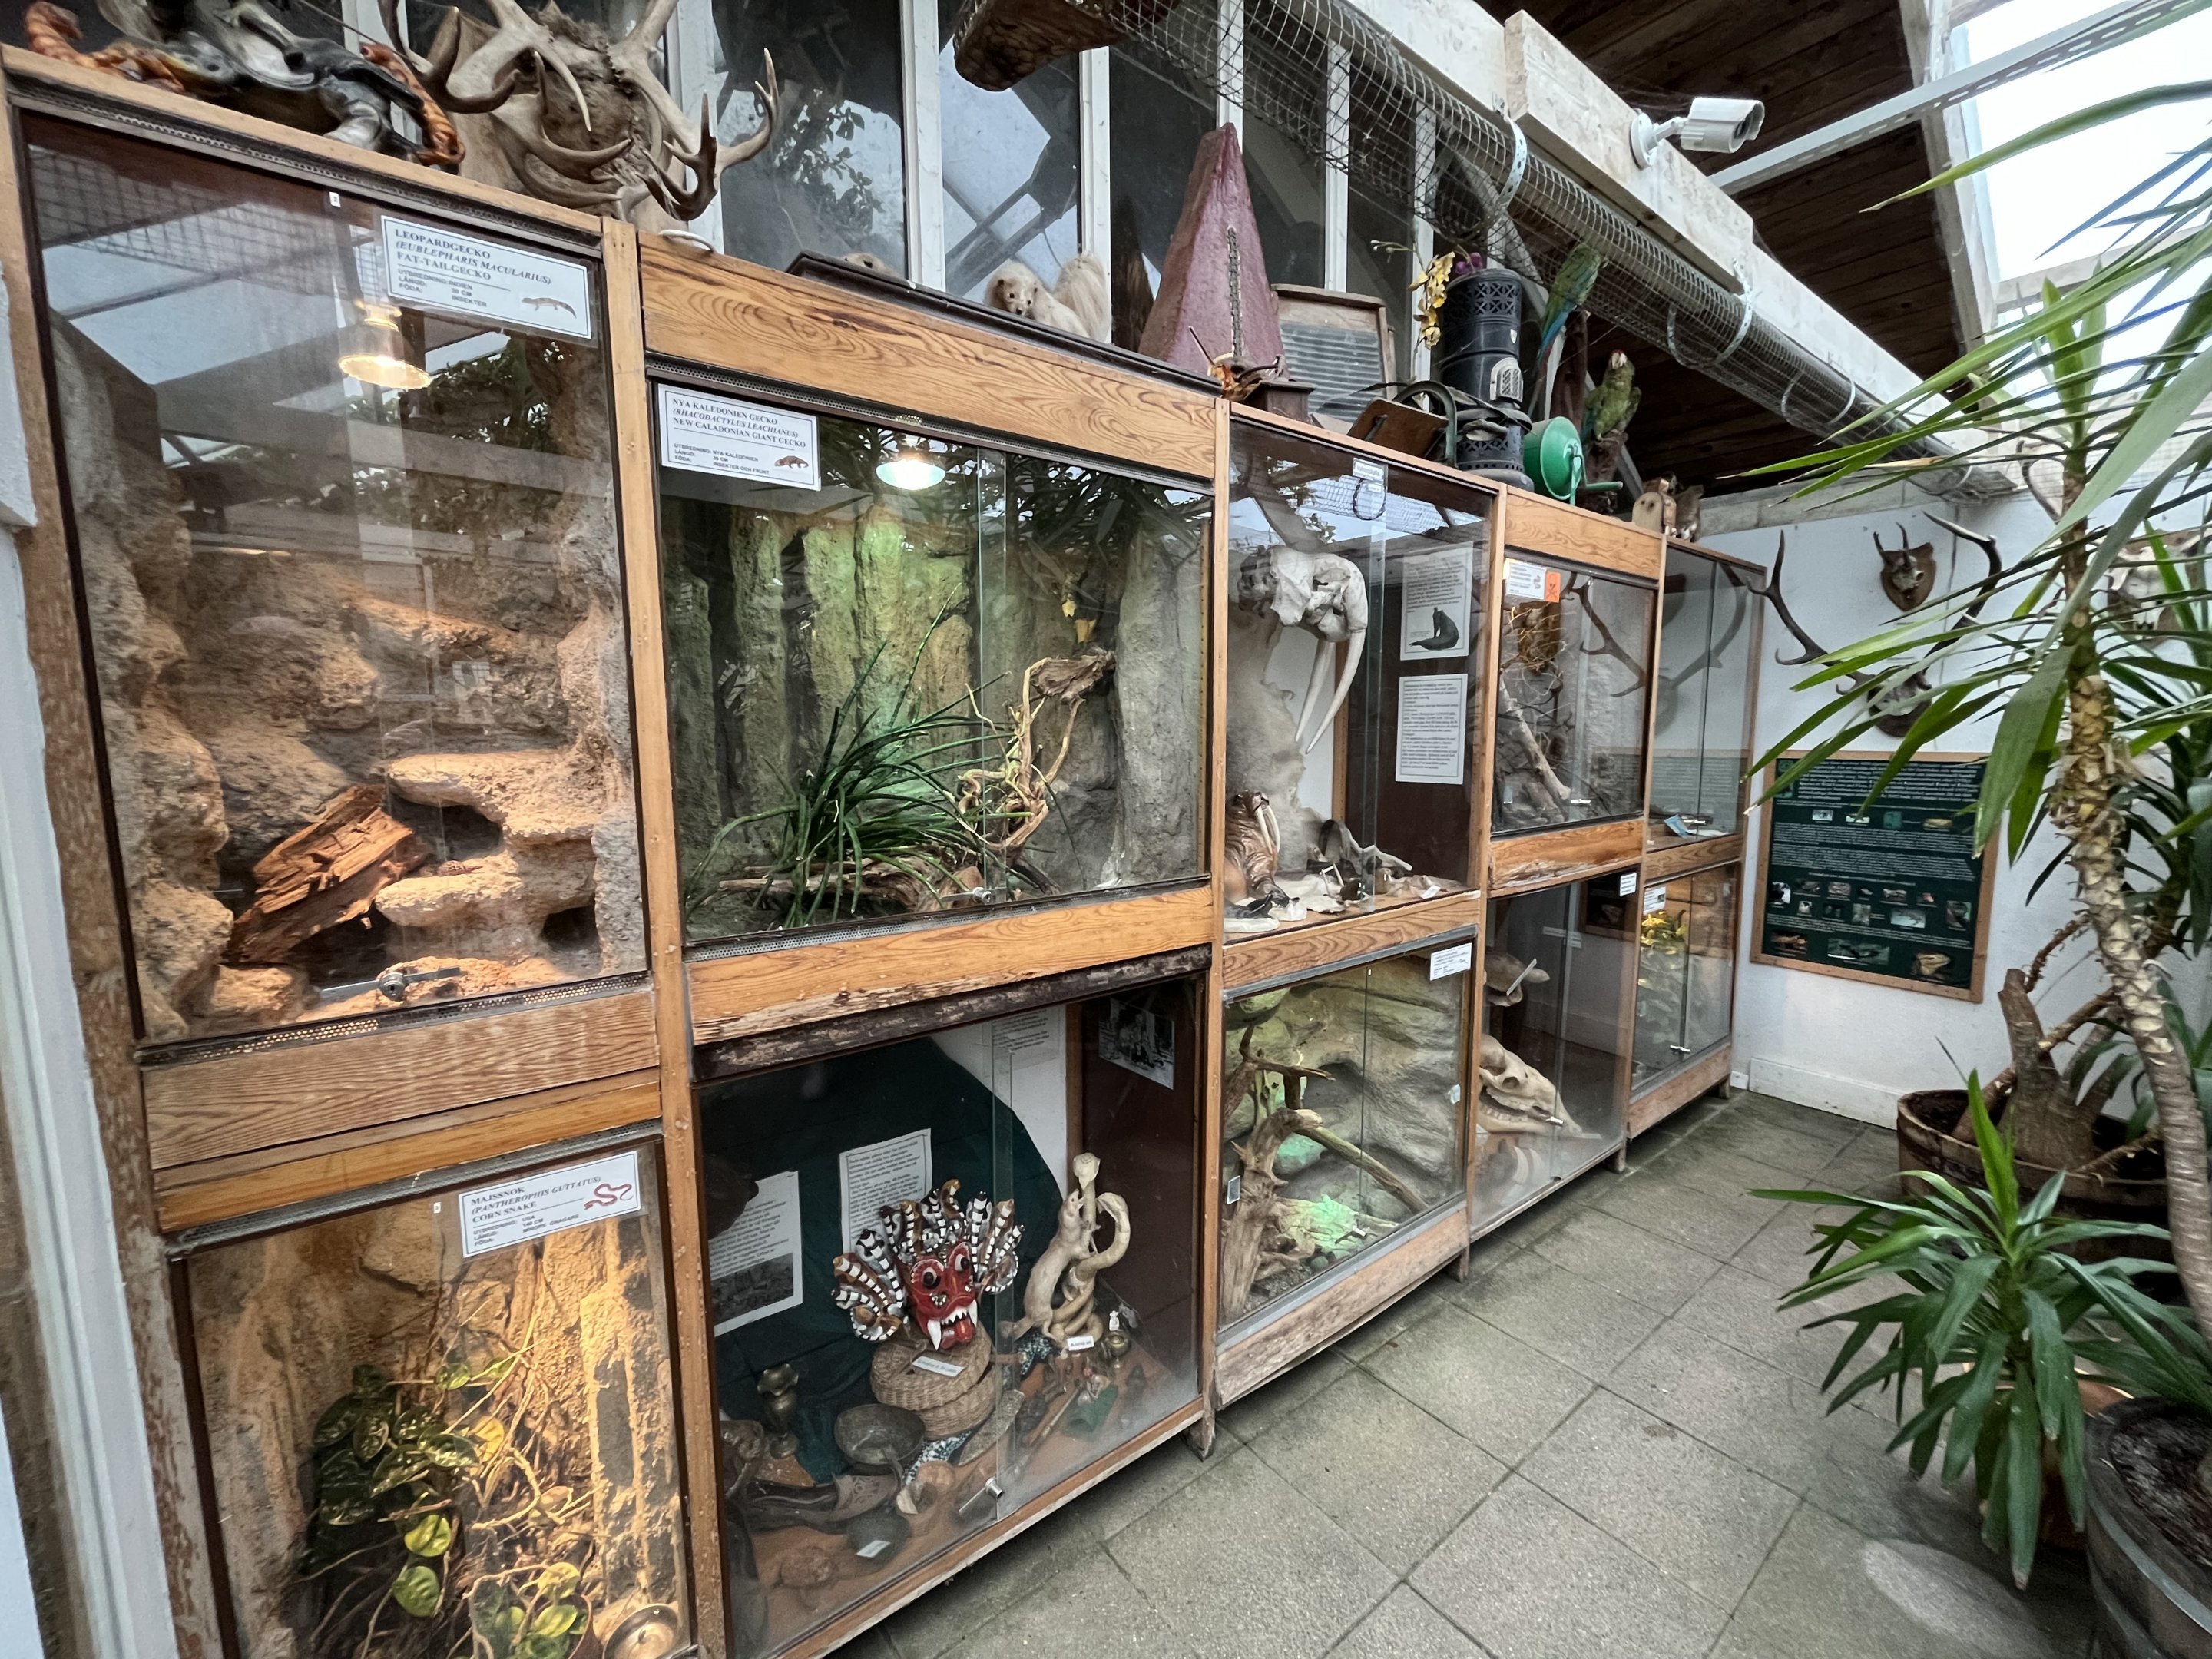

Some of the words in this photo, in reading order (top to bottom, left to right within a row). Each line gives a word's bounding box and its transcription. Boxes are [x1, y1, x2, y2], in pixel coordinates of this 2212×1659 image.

[395, 229, 491, 259] LEOPARDGECKO
[396, 241, 478, 267] (EUBLEPHARIS
[480, 261, 551, 285] MACULARIUS)
[397, 252, 491, 281] FAT-TAILGECKO
[452, 295, 487, 306] INSEKTER
[672, 398, 690, 408] NYA
[693, 401, 747, 419] KALEDONIEN
[749, 414, 777, 425] GECKO
[673, 408, 747, 428] (RHACODACTYLUS
[748, 422, 799, 439] LEACHIANUS)
[674, 417, 693, 426] NEW
[695, 421, 750, 437] CALADONIAN
[753, 432, 776, 442] GIANT
[779, 437, 806, 448] GECKO
[725, 452, 758, 462] KALEDONIEN
[472, 1190, 549, 1215] (PANTHEROPHIS
[552, 1176, 601, 1194] GUTTATUS)
[472, 1187, 525, 1206] MAJSSNOK
[472, 1211, 501, 1224] CORN
[503, 1201, 537, 1216] SNAKE
